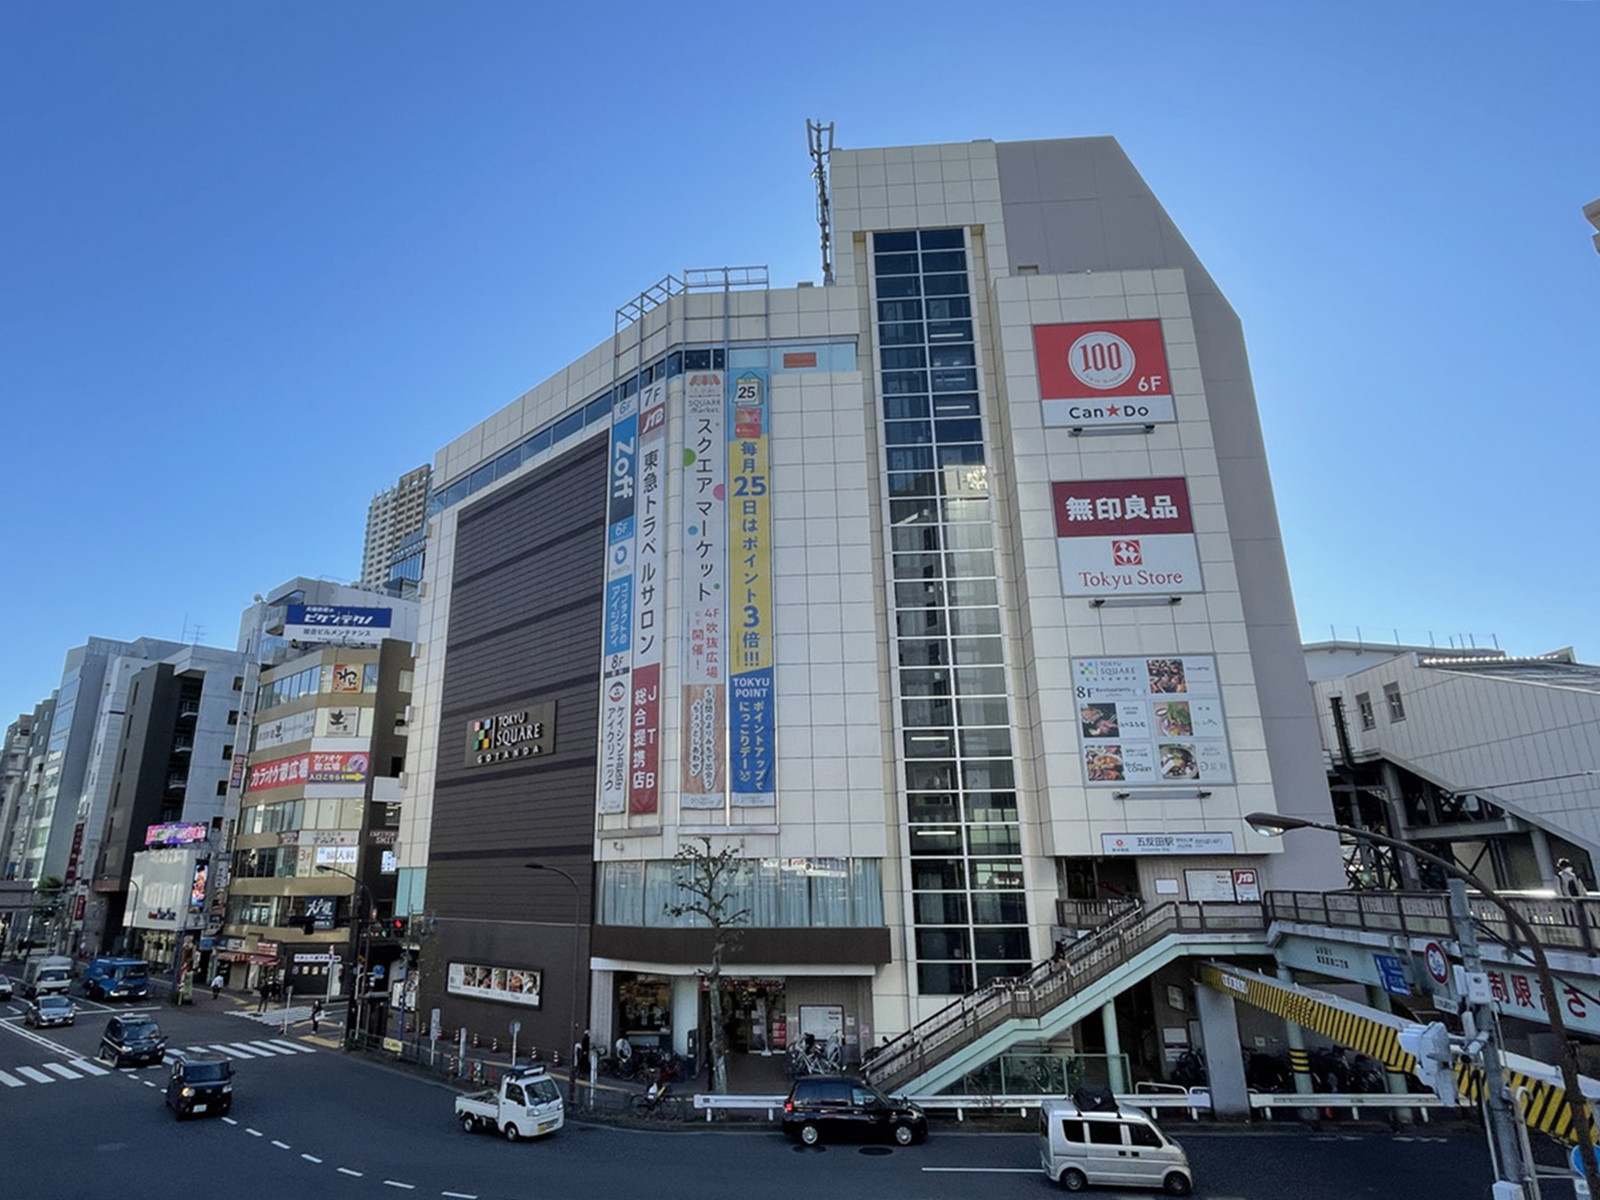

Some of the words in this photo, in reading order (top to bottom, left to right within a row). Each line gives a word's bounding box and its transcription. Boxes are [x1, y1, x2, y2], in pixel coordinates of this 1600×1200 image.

[1080, 341, 1122, 372] 100
[738, 386, 756, 399] 25
[1138, 375, 1162, 392] 6F
[644, 386, 662, 407] 7F
[688, 399, 720, 408] SQUARE
[619, 401, 631, 414] 6F
[1068, 403, 1104, 419] Can
[1124, 404, 1149, 417] Do
[642, 407, 664, 434] JTB
[613, 436, 635, 499] Zoff
[695, 418, 714, 601] スクエアマーケット
[1066, 494, 1179, 521] 無印良品
[615, 522, 627, 537] 6F
[640, 448, 659, 655] 東急トラベルサロン
[1079, 571, 1132, 590] Tokyu
[1137, 570, 1183, 586] Store
[303, 628, 372, 637] 総合ビルメンテナンス
[704, 608, 719, 678] 4F吹抜広場
[611, 654, 624, 669] 8F
[1100, 667, 1136, 675] SQUARE
[733, 677, 770, 688] TOKYU
[735, 688, 768, 698] POINT
[1076, 686, 1094, 699] 8F
[498, 712, 525, 727] TOKYU
[496, 723, 541, 746] SQUARE
[632, 687, 647, 790] 総合提携店
[477, 745, 540, 764] GOTANDA
[604, 707, 616, 792] アイクリニック
[753, 701, 765, 791] ポイントアップで
